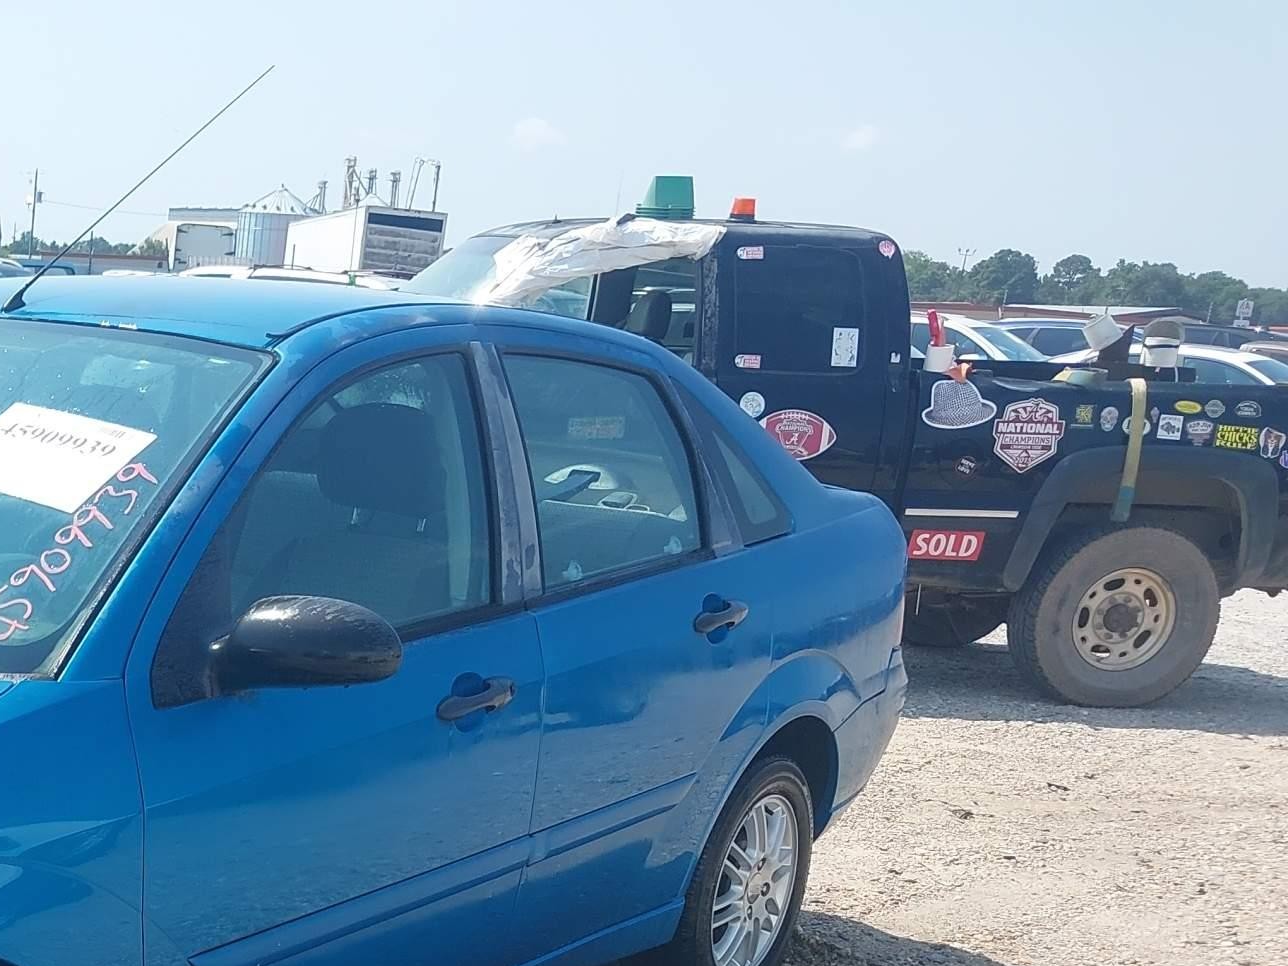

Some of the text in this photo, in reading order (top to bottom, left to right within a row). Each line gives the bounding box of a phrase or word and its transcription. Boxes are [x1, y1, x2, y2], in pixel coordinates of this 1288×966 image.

[776, 424, 813, 433] CHAMPIONS
[998, 422, 1060, 434] NATIONAL
[1219, 424, 1259, 434] HIPPIE
[0, 423, 117, 456] 45909939
[1003, 435, 1051, 444] CHAMPIONS
[1217, 431, 1257, 443] CHICKS
[1216, 439, 1257, 450] RULE
[912, 533, 978, 557] SOLD
